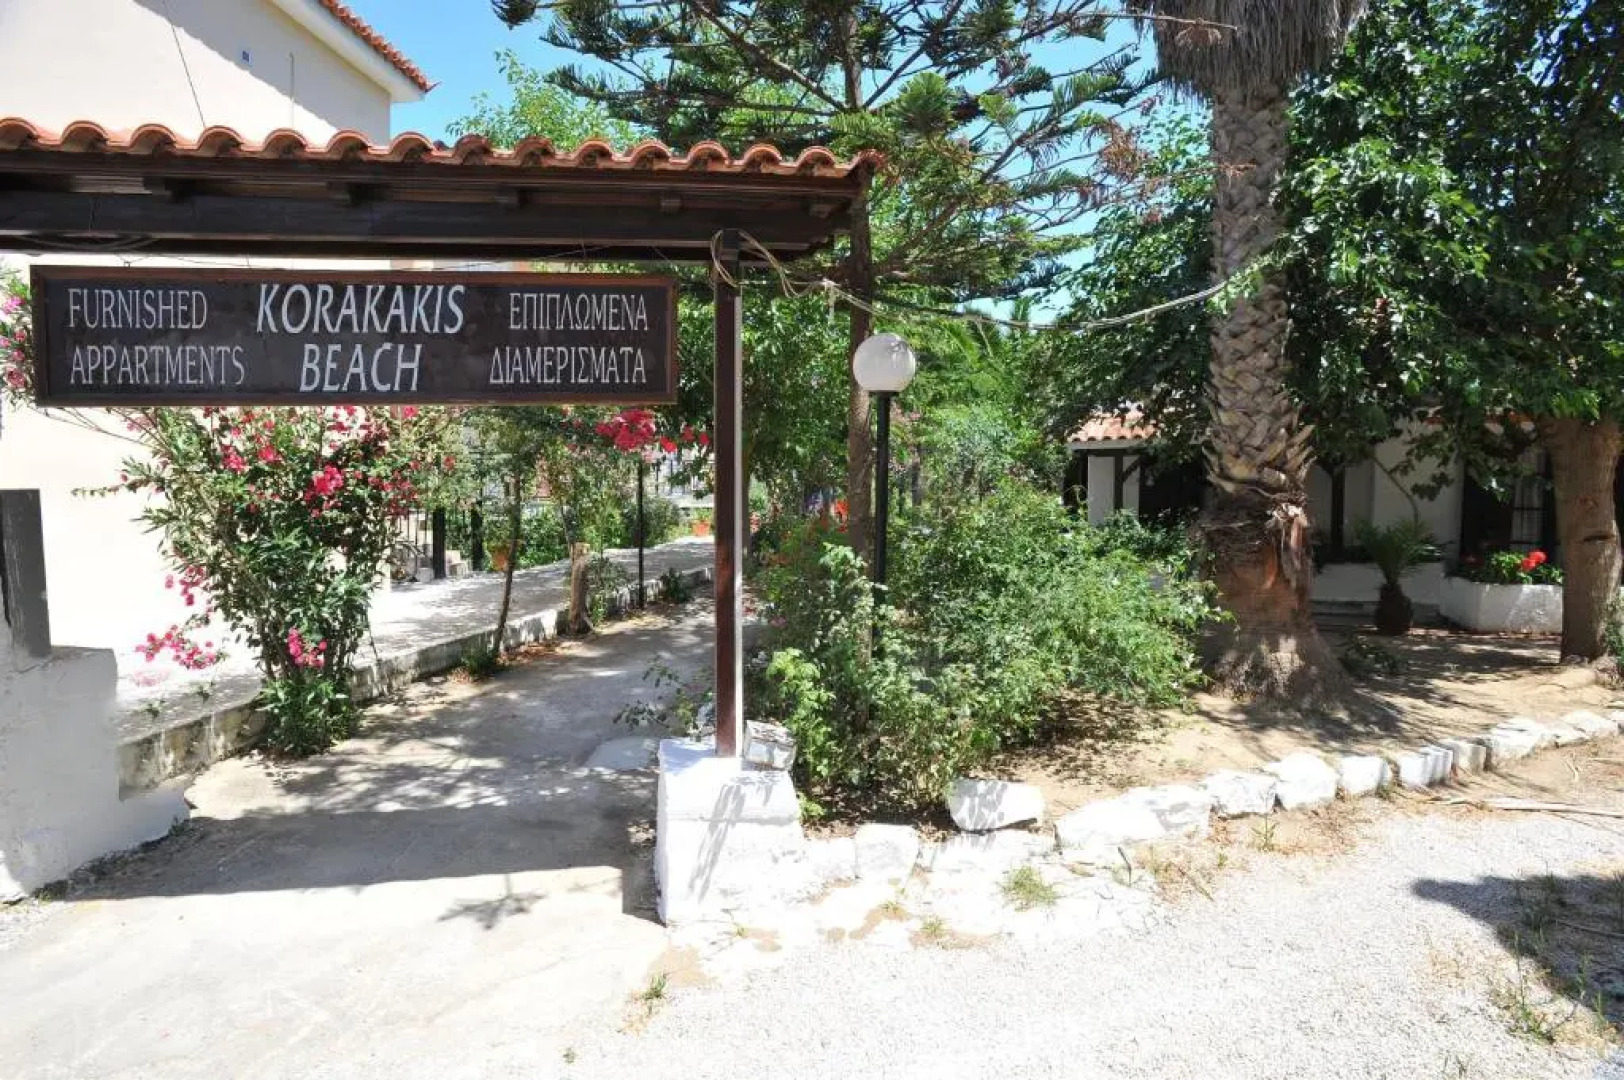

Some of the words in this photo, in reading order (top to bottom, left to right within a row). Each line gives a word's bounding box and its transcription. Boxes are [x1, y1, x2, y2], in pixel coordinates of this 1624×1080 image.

[67, 288, 208, 329] FURNISHED
[256, 283, 465, 334] KORAKAKIS
[508, 292, 649, 331] ΕΠΙΠΛΩΜΕΝΑ
[70, 345, 246, 385] APPARTMENTS
[299, 342, 422, 392] BEACH
[489, 346, 647, 384] ΔΙΑΜΕΡΙΣΜΑΤΑ
